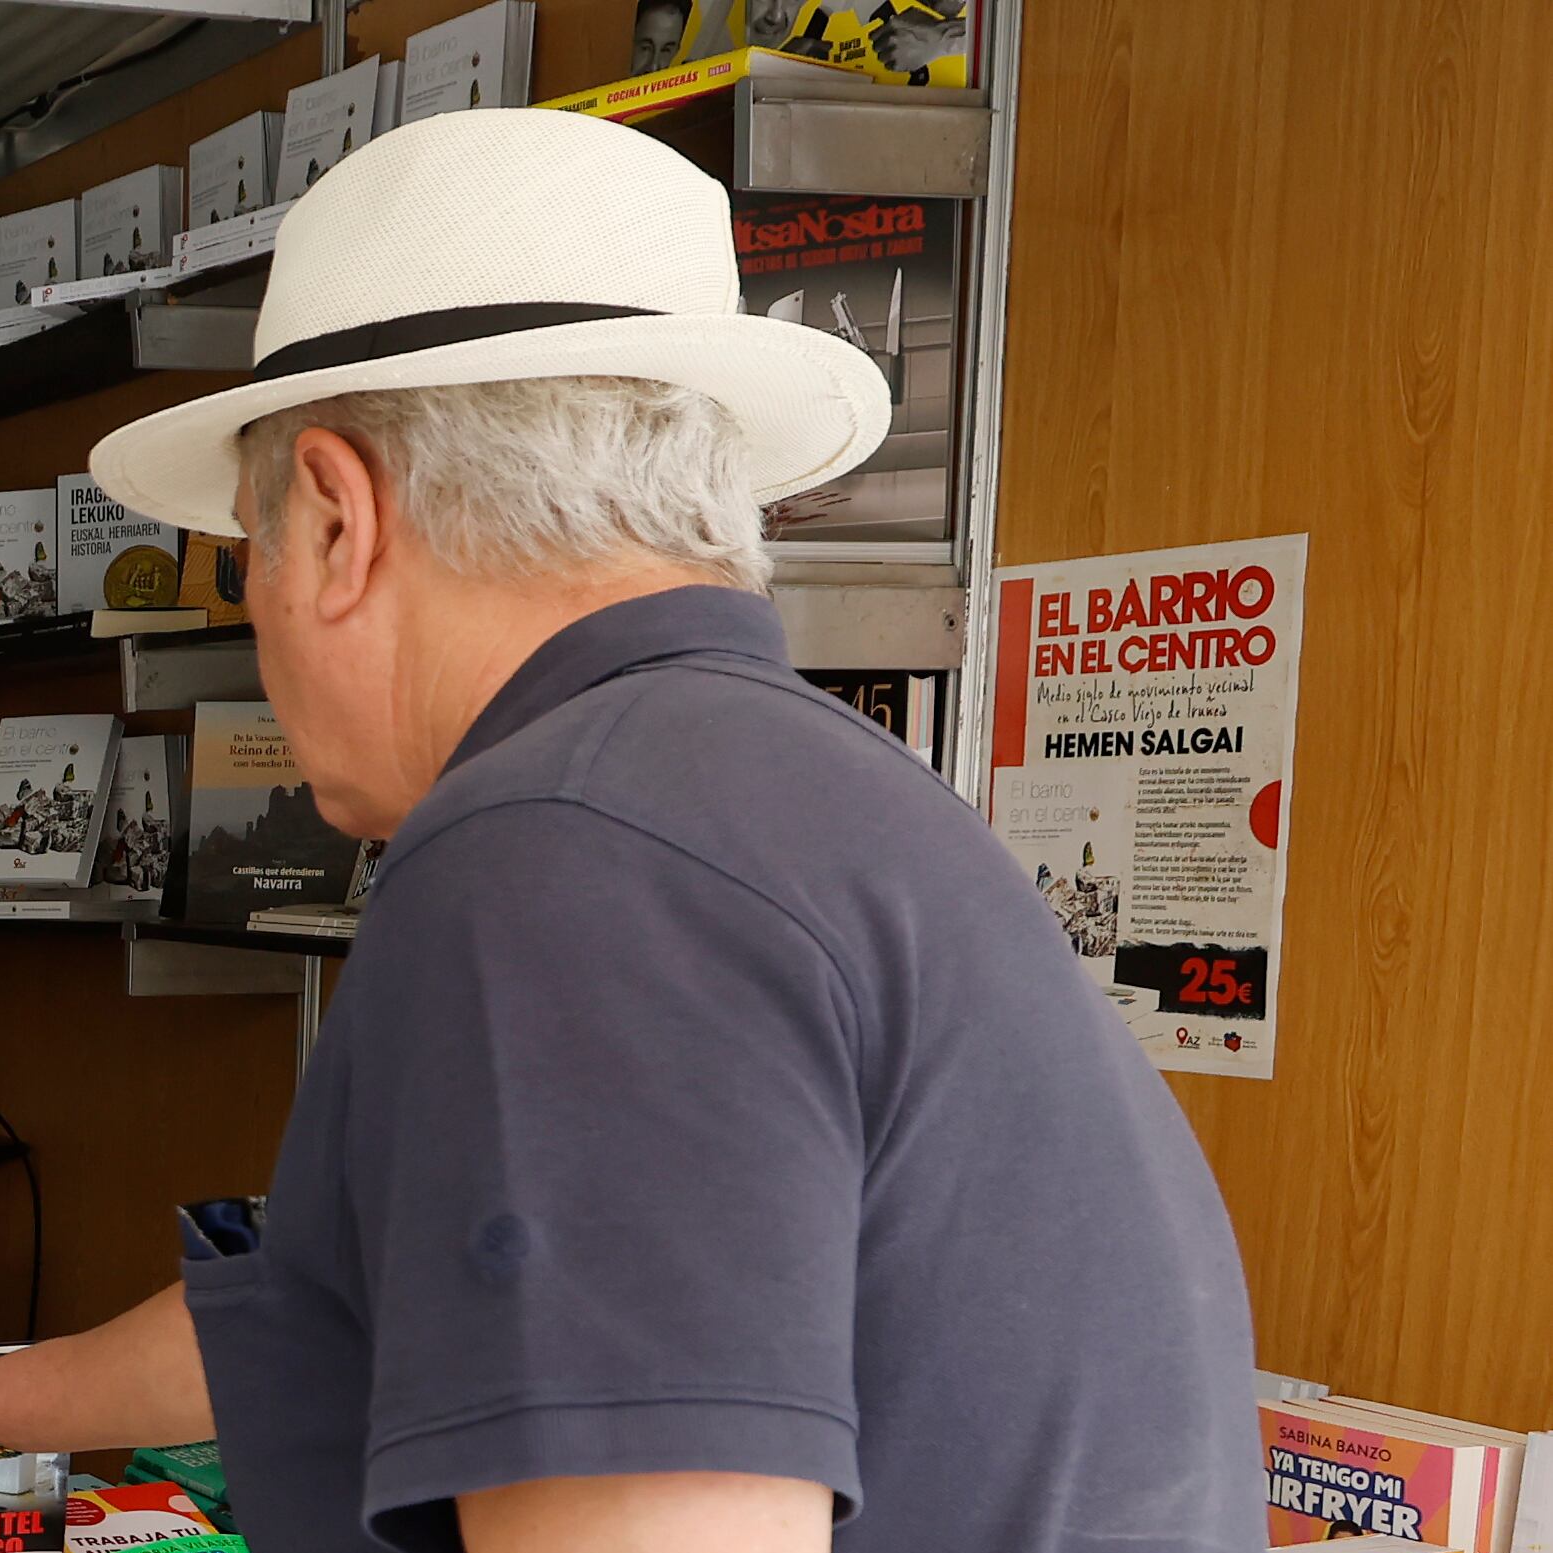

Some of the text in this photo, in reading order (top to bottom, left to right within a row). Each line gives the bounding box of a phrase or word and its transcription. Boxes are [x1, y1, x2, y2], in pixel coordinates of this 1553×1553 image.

[607, 70, 699, 104] COCINA Y VENCERÁS
[71, 504, 125, 524] LEKUKO
[71, 523, 160, 542] EUSKAL HERRIAREN
[71, 542, 112, 556] HISTORIA
[1038, 566, 1274, 637] EL BARRIO
[1035, 626, 1276, 677] EN EL CENTRO
[1038, 670, 1254, 710] Medio siglo de movimiento vecinal
[1057, 715, 1070, 723] en
[1075, 700, 1085, 723] el
[1090, 703, 1126, 724] Casco
[1132, 699, 1162, 728] Viejo
[1168, 701, 1181, 718] de
[1045, 726, 1243, 758] HEMEN SALGAI
[1179, 956, 1252, 1005] 25€
[1279, 1427, 1392, 1462] SABINA BANZO
[1270, 1448, 1402, 1500] YA TENGO MI
